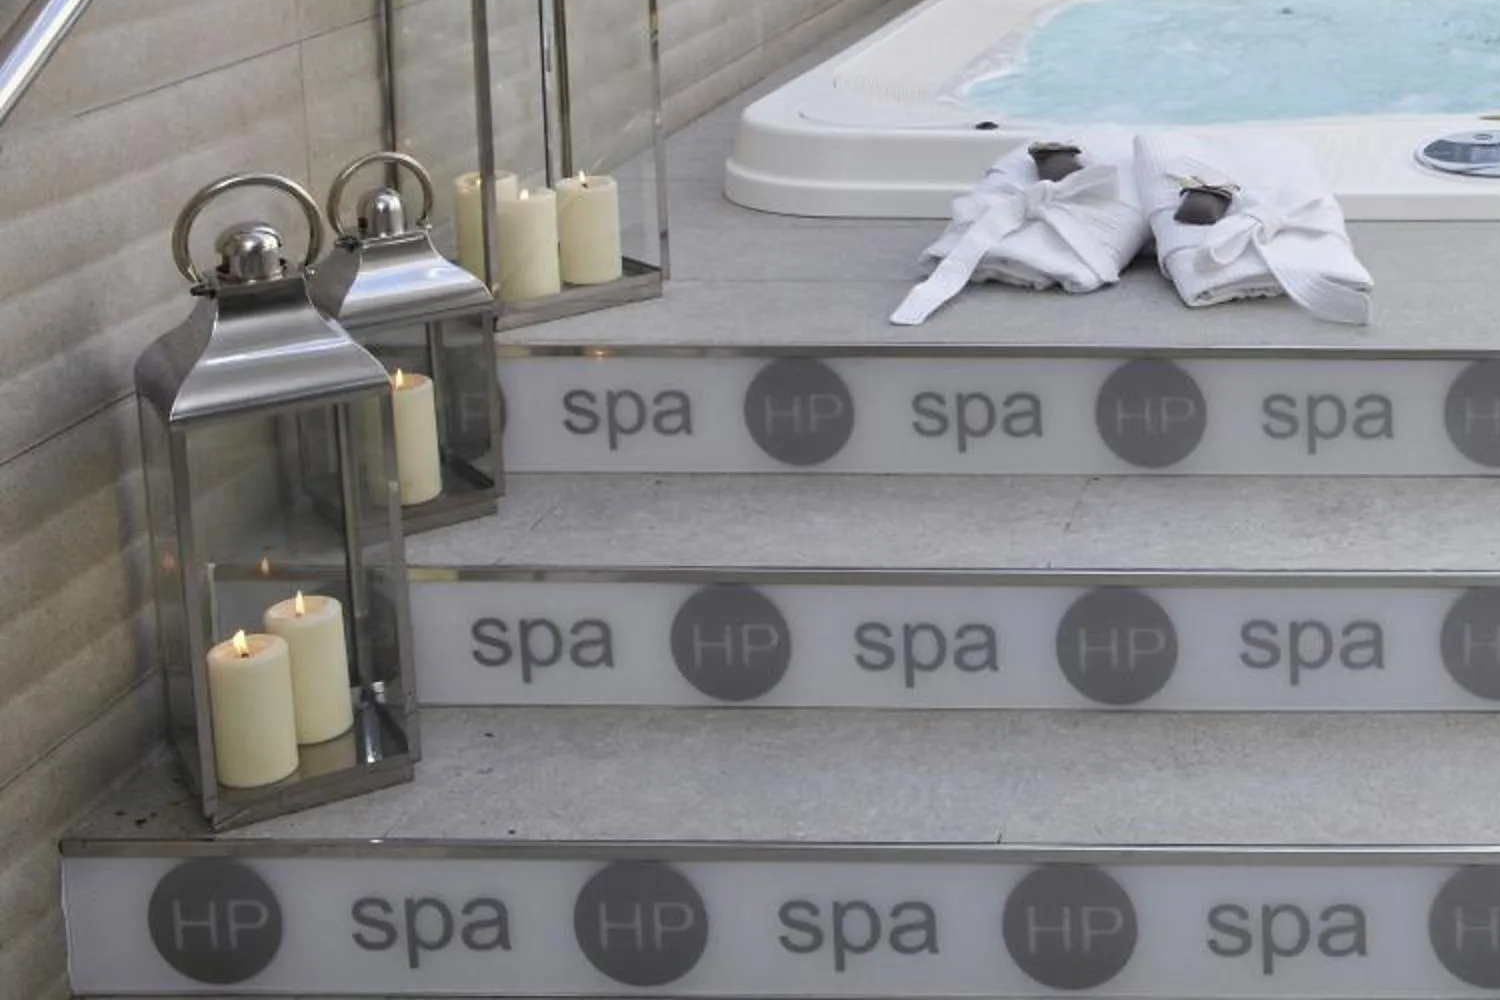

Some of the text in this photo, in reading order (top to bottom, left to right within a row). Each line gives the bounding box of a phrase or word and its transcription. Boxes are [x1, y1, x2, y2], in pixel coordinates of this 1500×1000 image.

[563, 390, 692, 450] spa
[763, 393, 842, 434] HP
[912, 392, 1042, 453] spa
[1115, 395, 1194, 435] HP
[1263, 394, 1393, 454] spa
[472, 618, 613, 684] spa
[694, 623, 777, 667] HP
[855, 622, 998, 688] spa
[1079, 627, 1166, 673] HP
[1240, 620, 1384, 686] spa
[173, 901, 269, 950] HP
[352, 898, 511, 969] spa
[599, 903, 695, 950] HP
[779, 900, 939, 972] spa
[1028, 906, 1123, 955] HP
[1207, 904, 1367, 975] spa
